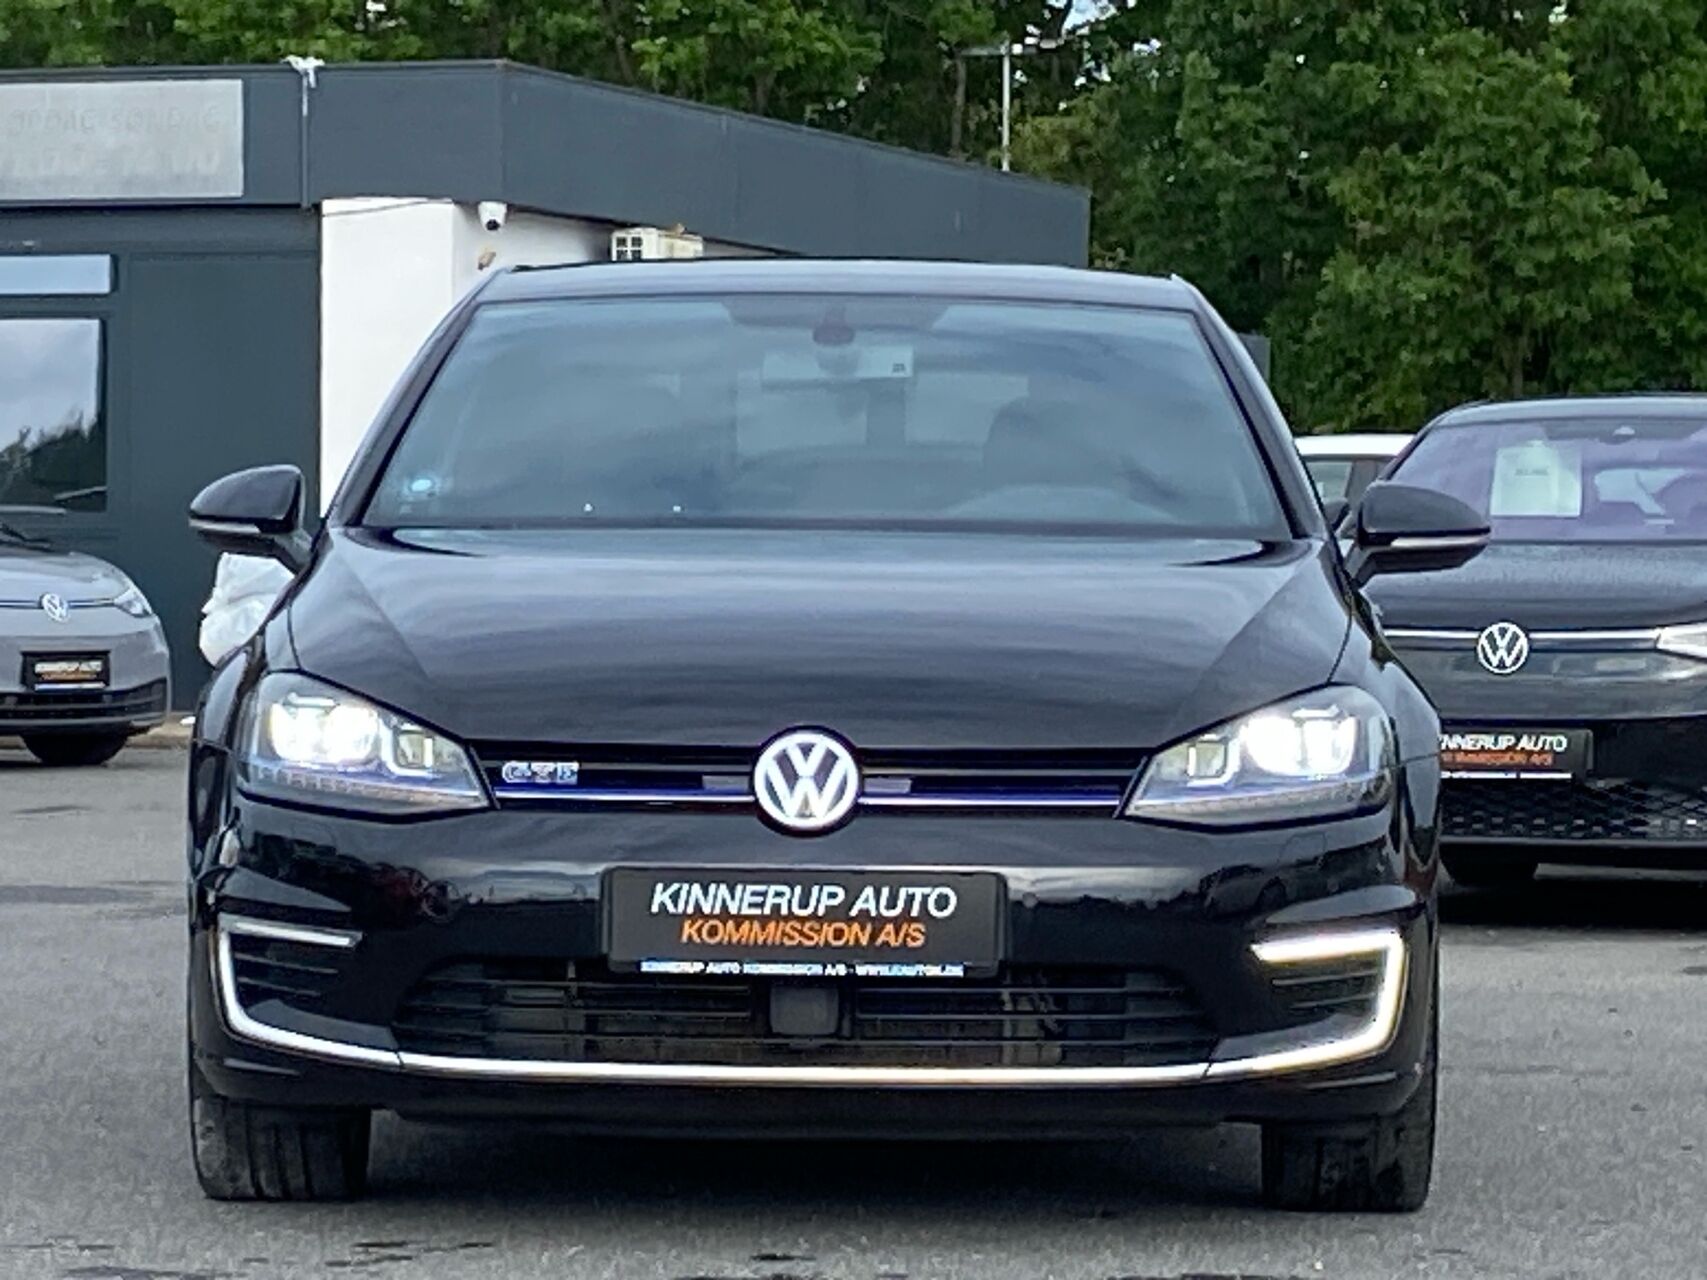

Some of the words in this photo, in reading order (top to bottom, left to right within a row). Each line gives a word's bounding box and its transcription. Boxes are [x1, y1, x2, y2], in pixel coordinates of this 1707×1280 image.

[1478, 622, 1528, 673] VW
[1517, 735, 1568, 751] AUTO
[502, 761, 580, 784] GTE
[754, 732, 858, 829] VW
[650, 882, 845, 917] KINNERUP
[849, 885, 958, 918] AUTO
[680, 919, 872, 947] KOMMISSION
[874, 921, 926, 947] A/S
